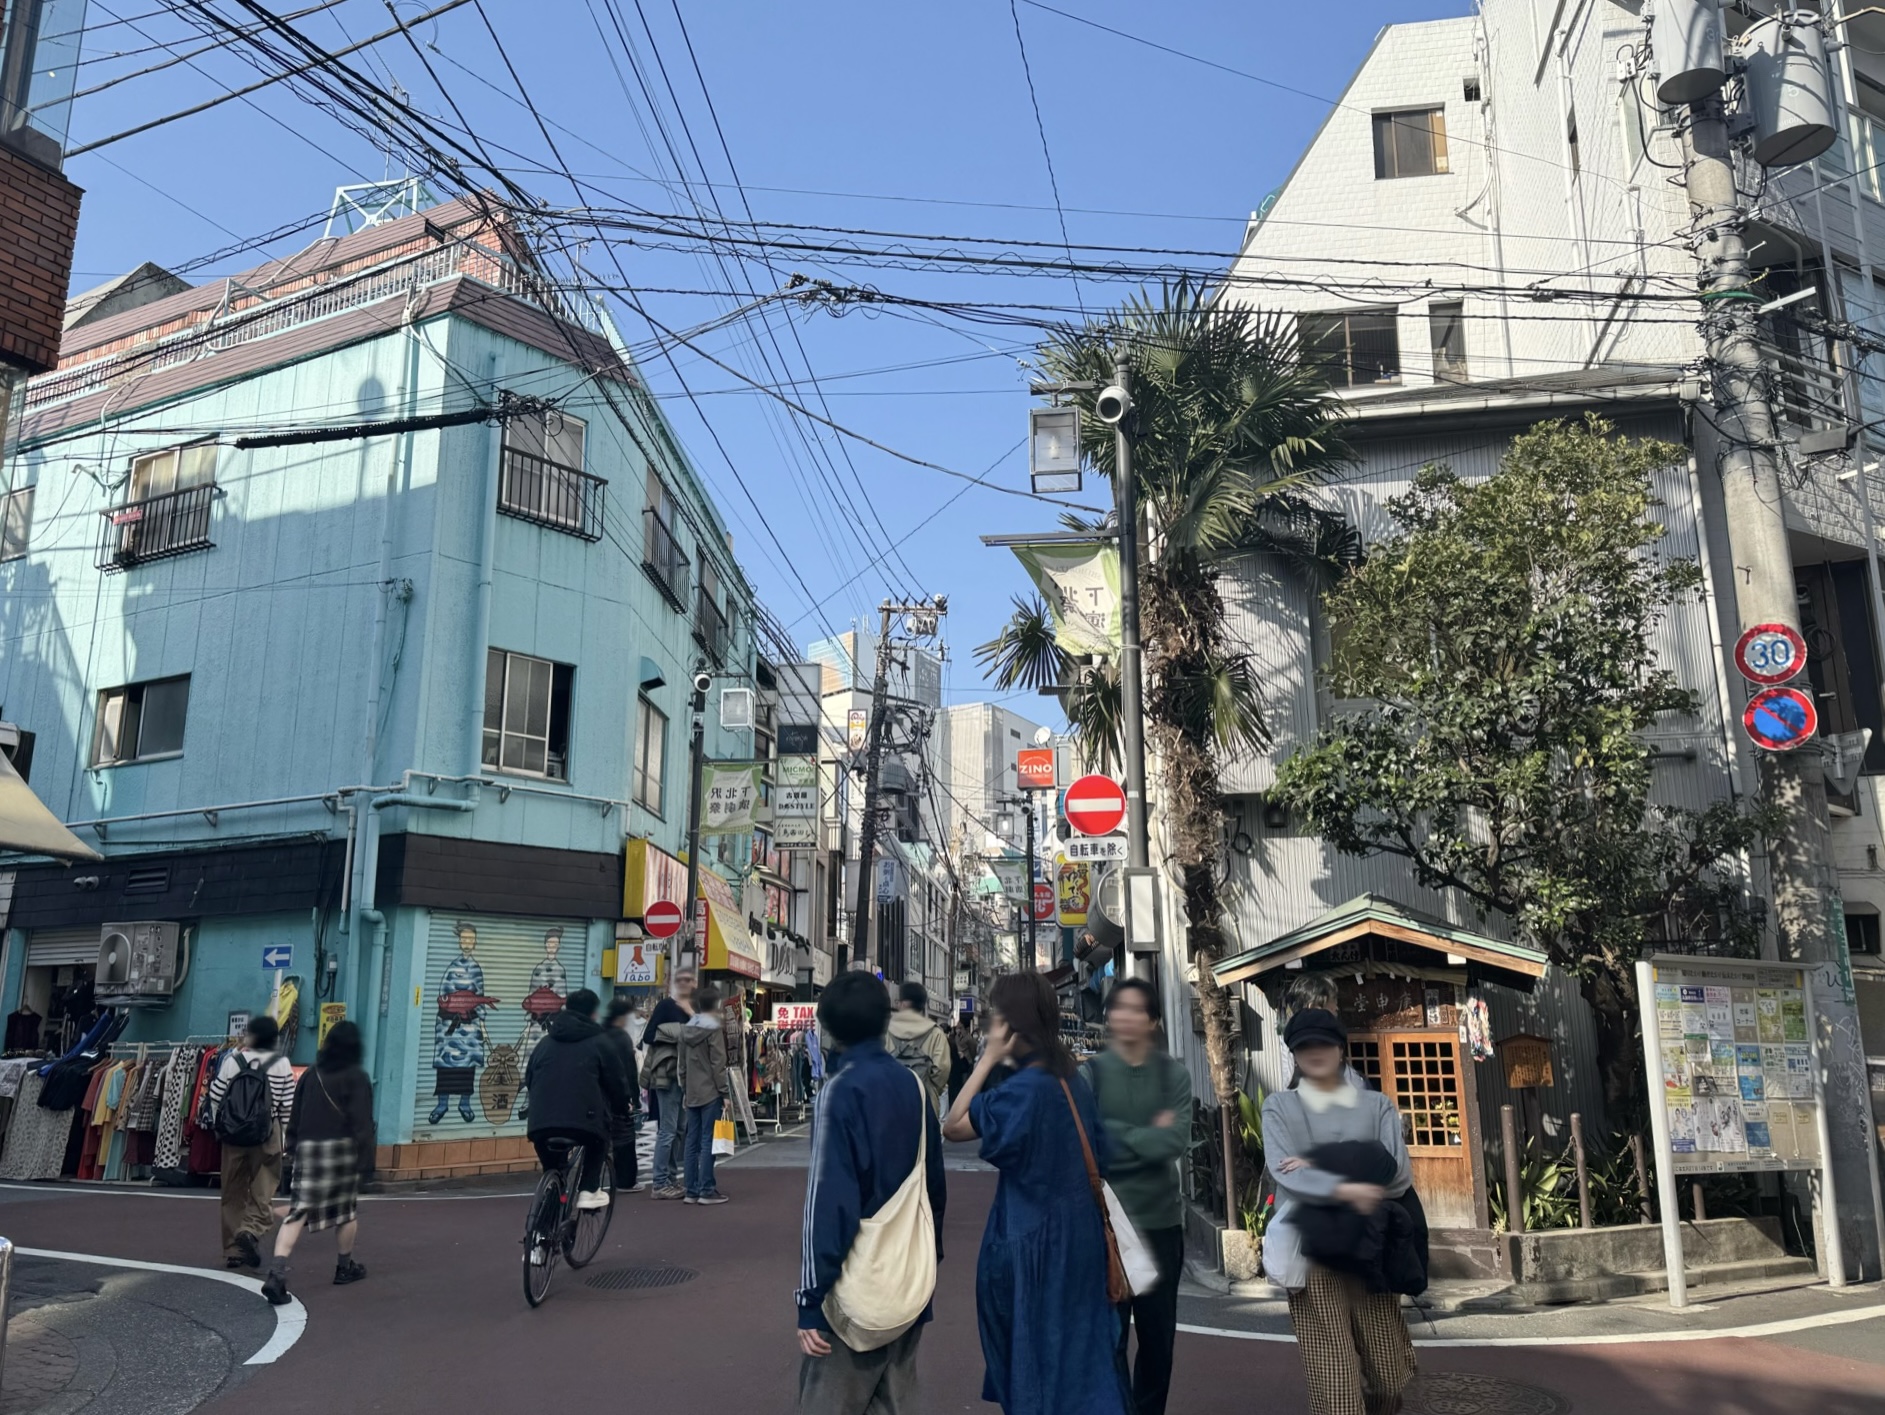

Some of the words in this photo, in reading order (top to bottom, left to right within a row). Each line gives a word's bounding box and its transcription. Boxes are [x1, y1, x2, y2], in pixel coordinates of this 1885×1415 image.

[1751, 639, 1790, 669] 30
[1019, 763, 1053, 774] ZINO
[1069, 842, 1123, 857] 自転車を除く
[624, 973, 650, 981] labo
[793, 1006, 814, 1018] TAX
[491, 1093, 508, 1109] 酒
